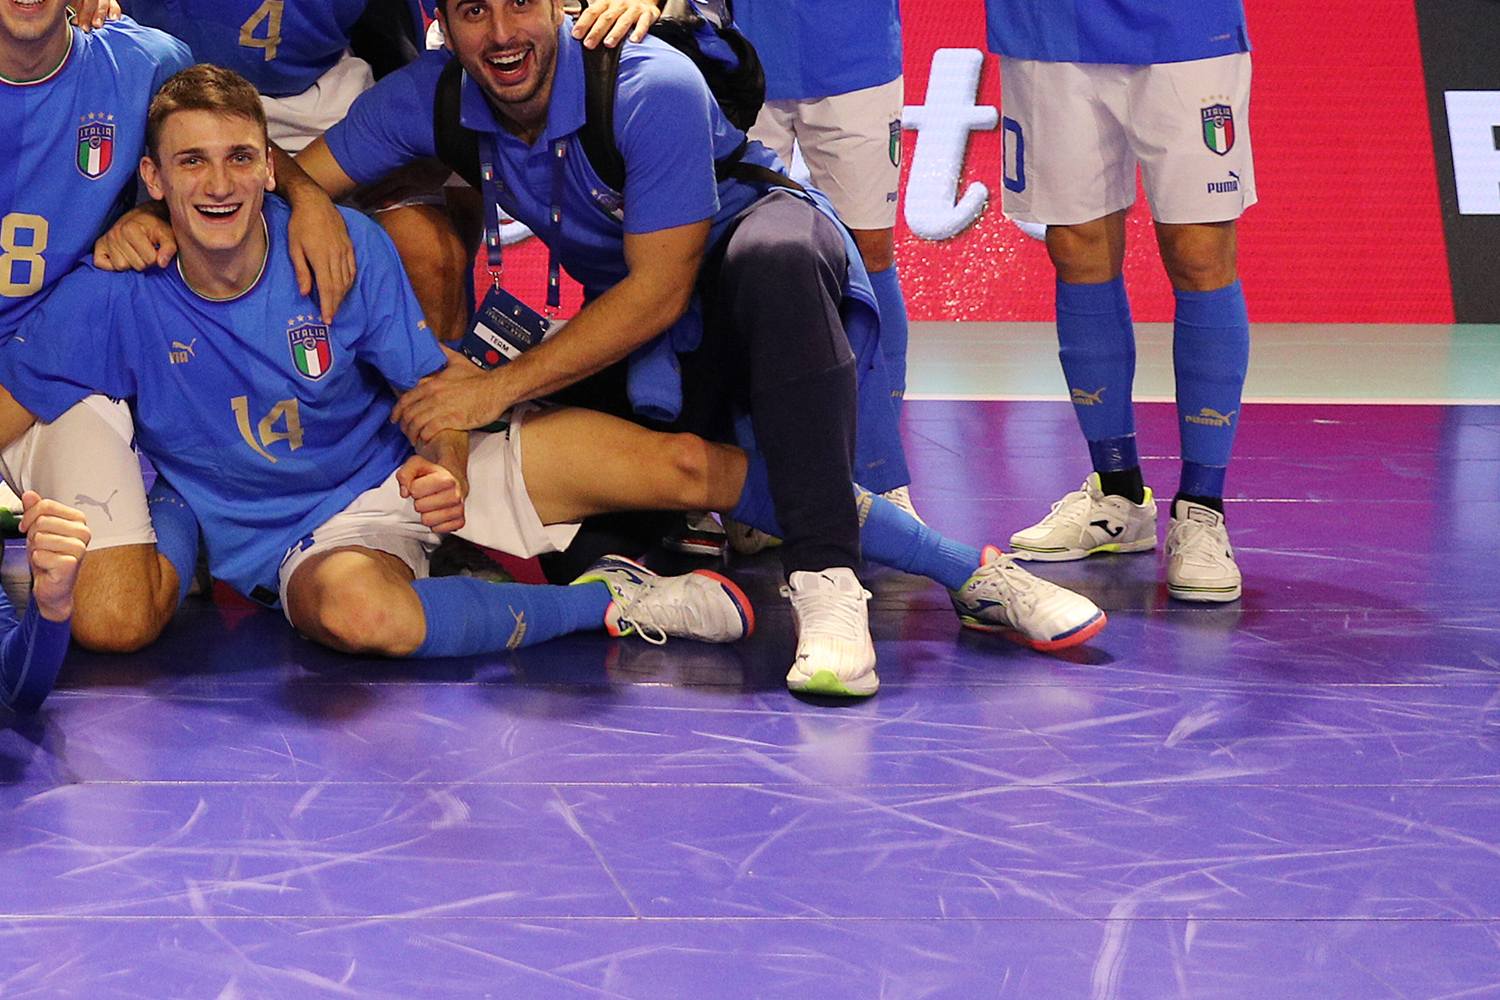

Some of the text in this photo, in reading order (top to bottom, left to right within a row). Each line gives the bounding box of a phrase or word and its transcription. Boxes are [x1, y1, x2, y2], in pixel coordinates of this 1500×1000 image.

[1202, 107, 1231, 118] ITALIA
[79, 126, 112, 137] ITALIA
[1206, 180, 1239, 194] PUMA
[291, 327, 326, 341] ITALIA
[230, 395, 306, 464] 14
